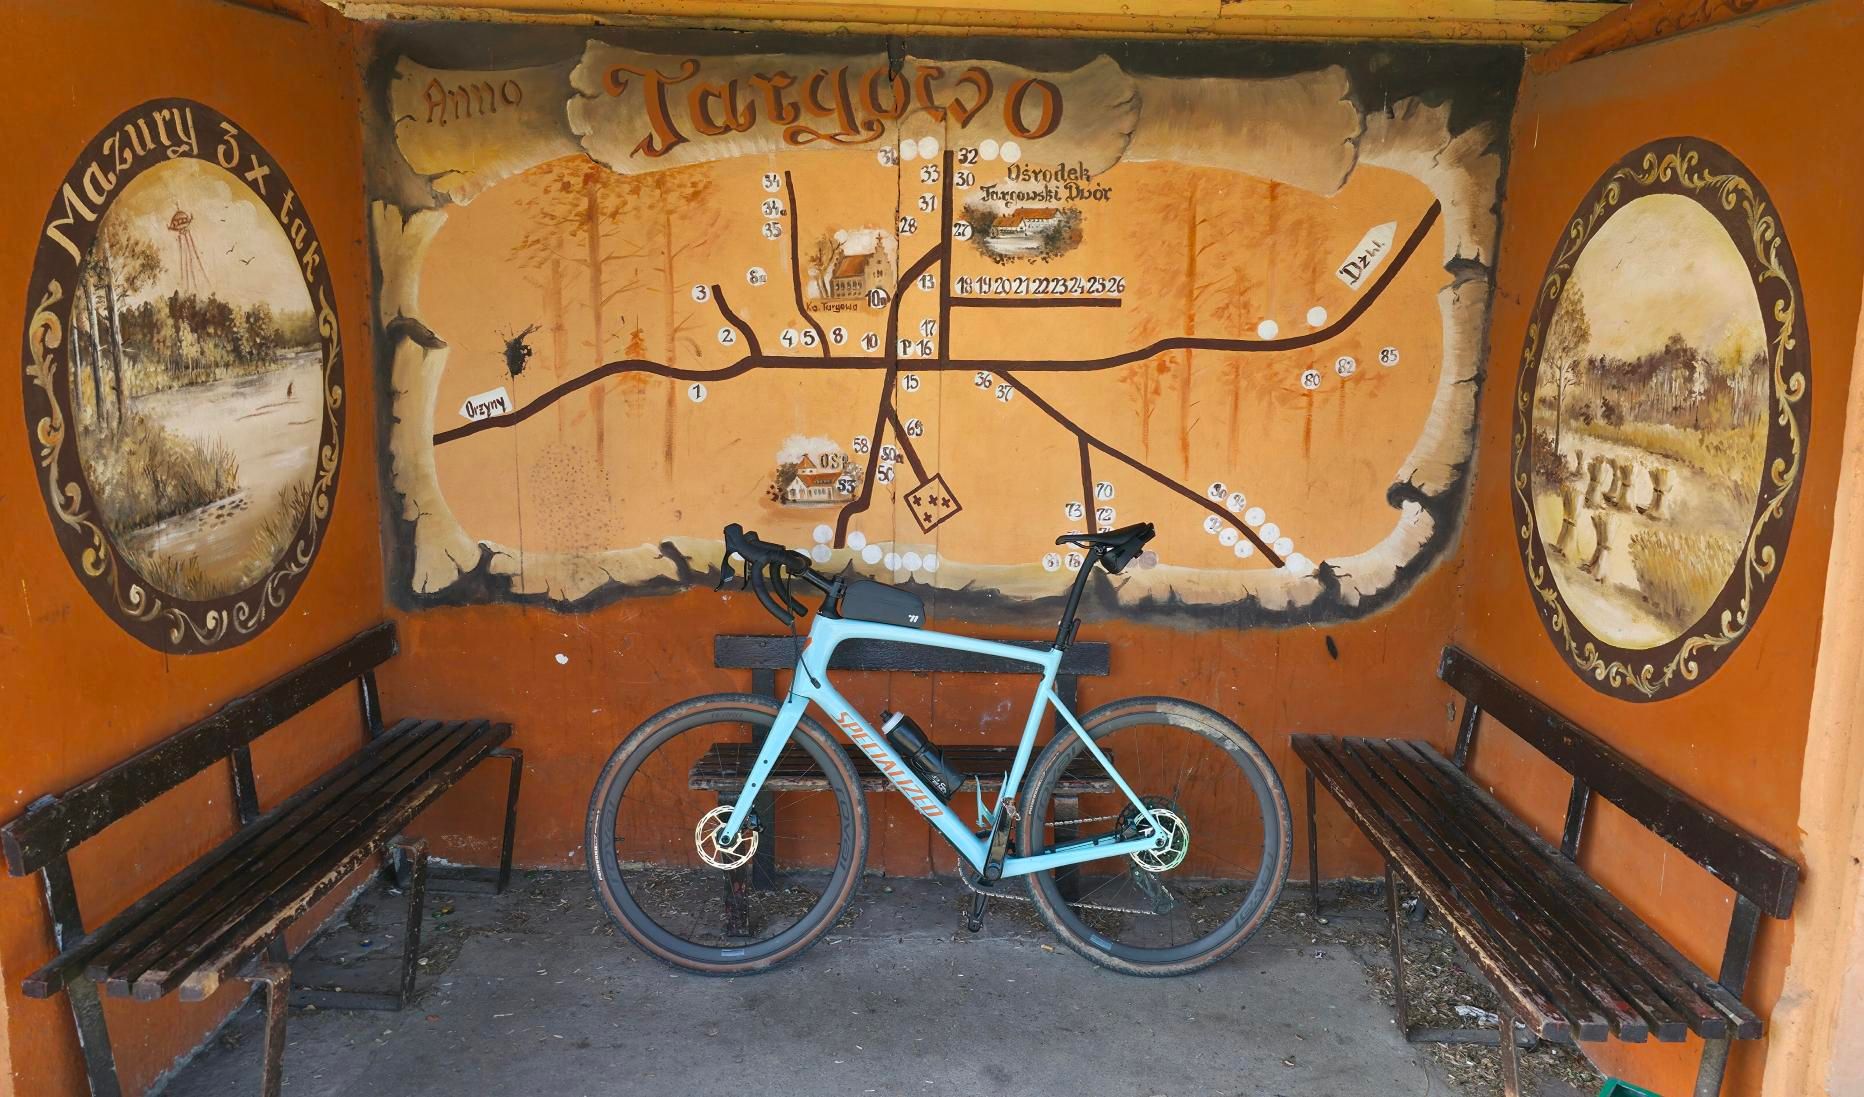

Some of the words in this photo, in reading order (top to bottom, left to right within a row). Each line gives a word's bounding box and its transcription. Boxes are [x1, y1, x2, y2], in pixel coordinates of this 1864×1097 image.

[424, 78, 523, 126] Anno
[602, 58, 1064, 158] Targowo
[958, 148, 978, 164] 32
[764, 174, 780, 188] 34
[921, 164, 940, 183] 33
[956, 171, 975, 187] 30
[1007, 161, 1091, 184] Ośrodek
[47, 107, 198, 266] Mazury
[217, 122, 239, 168] 3
[280, 189, 320, 283] tak
[919, 195, 936, 212] 31
[980, 184, 1062, 208] Targowski
[1064, 182, 1112, 202] Dwór
[764, 222, 781, 237] 35
[900, 216, 918, 234] 28
[954, 222, 970, 237] 27
[919, 274, 935, 289] 13
[957, 276, 973, 294] 18
[976, 276, 992, 294] 19
[994, 276, 1012, 294] 20
[1013, 276, 1030, 294] 21
[1032, 277, 1051, 294] 22
[1051, 277, 1069, 294] 23
[1069, 276, 1086, 294] 24
[1087, 276, 1106, 294] 25
[1107, 276, 1126, 294] 26
[695, 285, 707, 300] 3
[722, 329, 734, 343] 2
[832, 327, 844, 344] 8
[921, 319, 937, 337] 17
[782, 331, 793, 348] 4
[803, 330, 816, 346] 5
[861, 333, 879, 350] 10
[899, 339, 912, 355] P
[916, 339, 932, 356] 16
[1380, 349, 1397, 363] 85
[904, 374, 919, 391] 15
[976, 371, 992, 388] 36
[1304, 373, 1321, 387] 80
[692, 384, 702, 400] 1
[996, 384, 1013, 401] 37
[465, 397, 506, 418] Orzyny
[853, 438, 869, 454] 58
[1095, 482, 1114, 498] 70
[1065, 503, 1082, 518] 73
[1095, 508, 1113, 522] 72
[836, 710, 944, 818] SPECIALIZED
